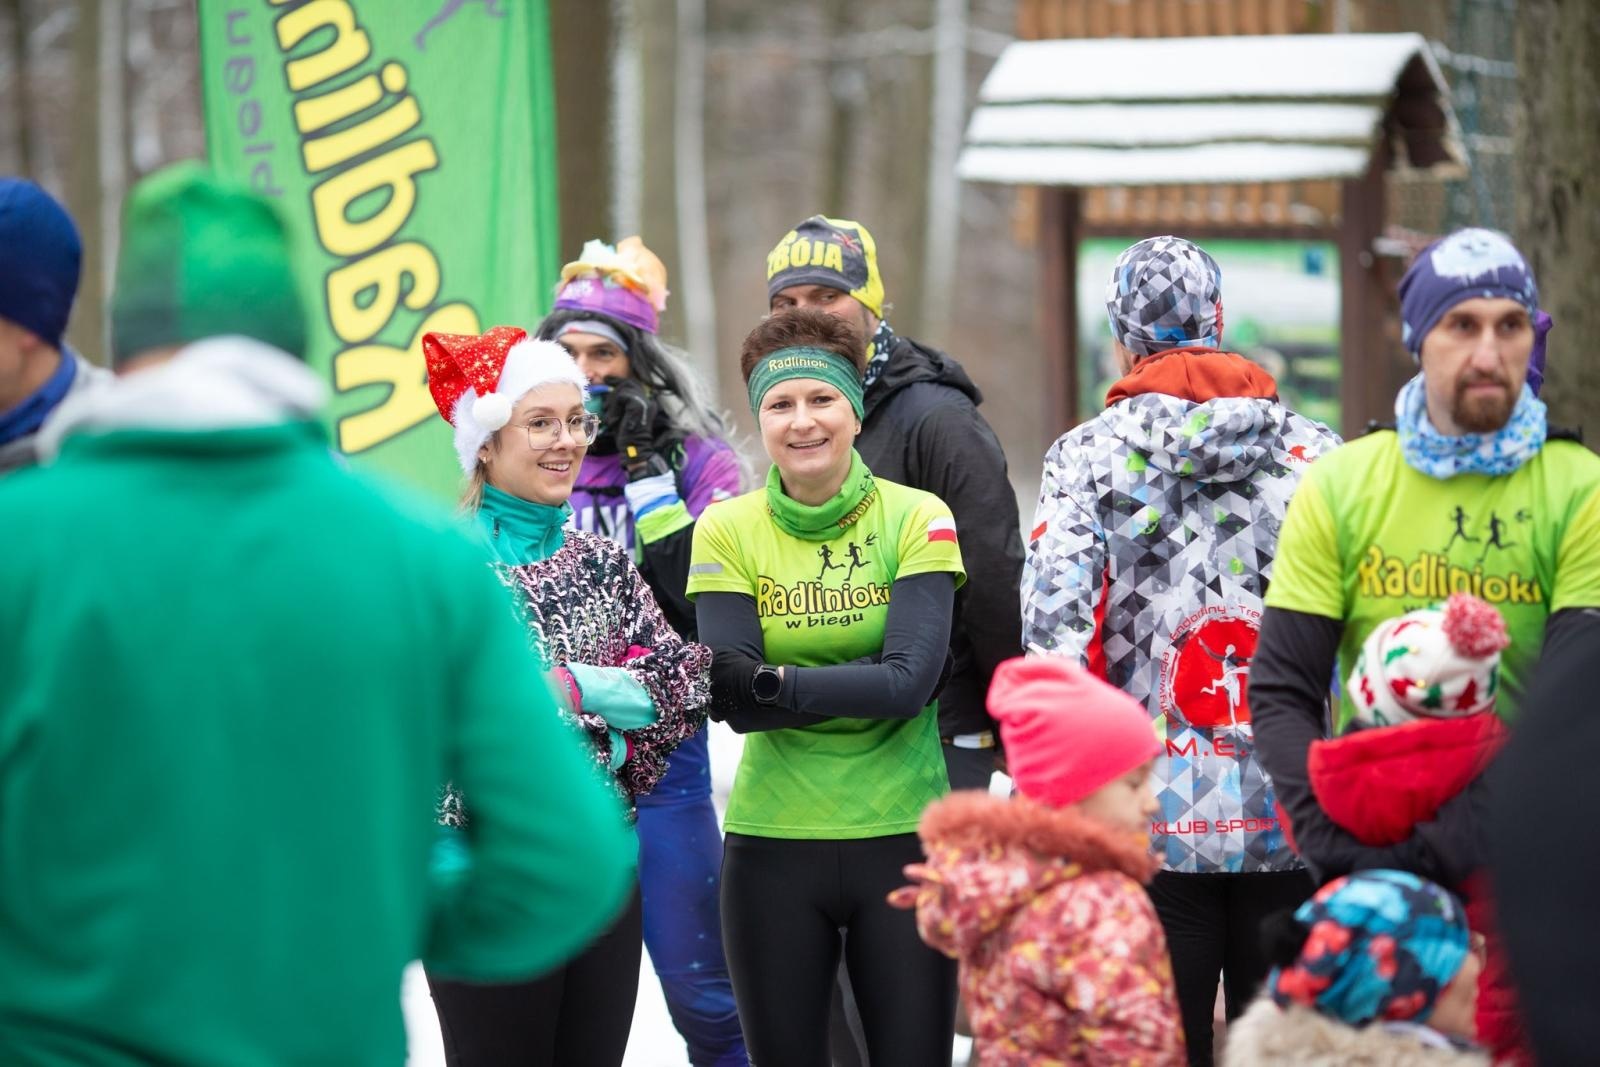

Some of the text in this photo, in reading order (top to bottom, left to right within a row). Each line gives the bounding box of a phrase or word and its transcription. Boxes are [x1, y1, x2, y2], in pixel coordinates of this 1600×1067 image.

[768, 356, 828, 373] Radlinioki
[1359, 545, 1542, 604] Radlinioki
[757, 575, 889, 618] Radlinioki
[785, 613, 864, 629] w biegu
[1238, 605, 1263, 623] Tre
[1165, 736, 1254, 758] M.E.
[1152, 819, 1209, 835] KLUB
